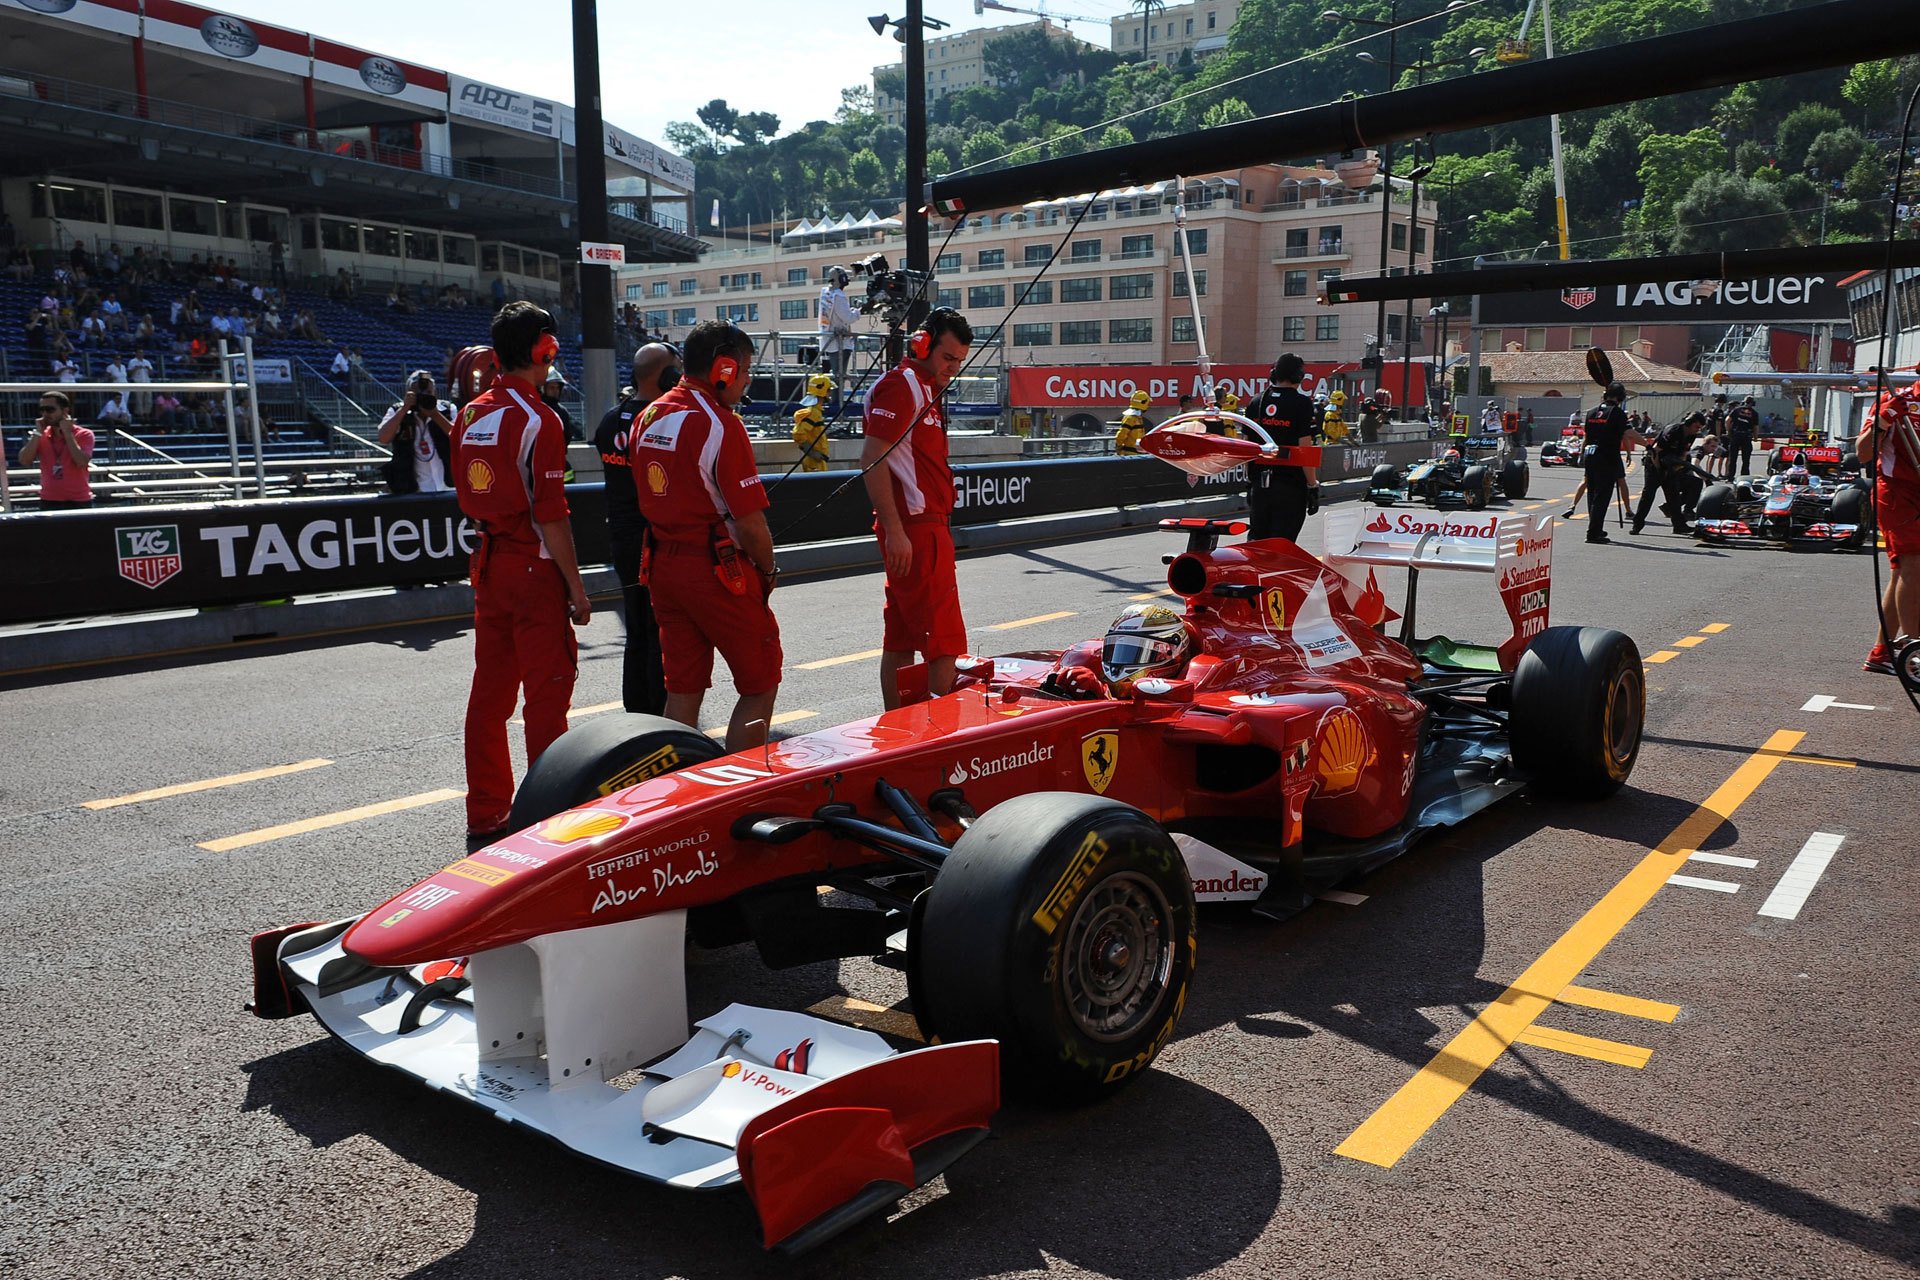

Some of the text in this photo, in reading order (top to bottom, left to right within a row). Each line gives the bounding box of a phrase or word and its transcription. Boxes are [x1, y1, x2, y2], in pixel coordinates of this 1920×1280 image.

[460, 84, 520, 111] ART
[596, 248, 622, 261] BRIEFING
[1045, 376, 1137, 399] CASINO
[1150, 379, 1179, 398] DE
[1253, 417, 1291, 428] vdafone
[1394, 514, 1497, 539] Santand
[126, 529, 171, 556] TAG
[1524, 537, 1552, 555] V-Power
[123, 557, 177, 585] HEUER
[1510, 559, 1550, 588] Santander
[1520, 593, 1538, 614] AMD
[1522, 615, 1546, 639] TATA
[1304, 636, 1338, 651] SCUDERIA
[1324, 642, 1353, 656] FERRARI
[969, 740, 1055, 780] Santander
[586, 831, 710, 881] Ferrari WORLD
[453, 861, 507, 883] PIRELLI
[591, 850, 720, 914] Abu Dhabi
[1032, 830, 1110, 936] PIRELLI
[401, 883, 461, 911] FIAT
[742, 1069, 796, 1097] V-Pow
